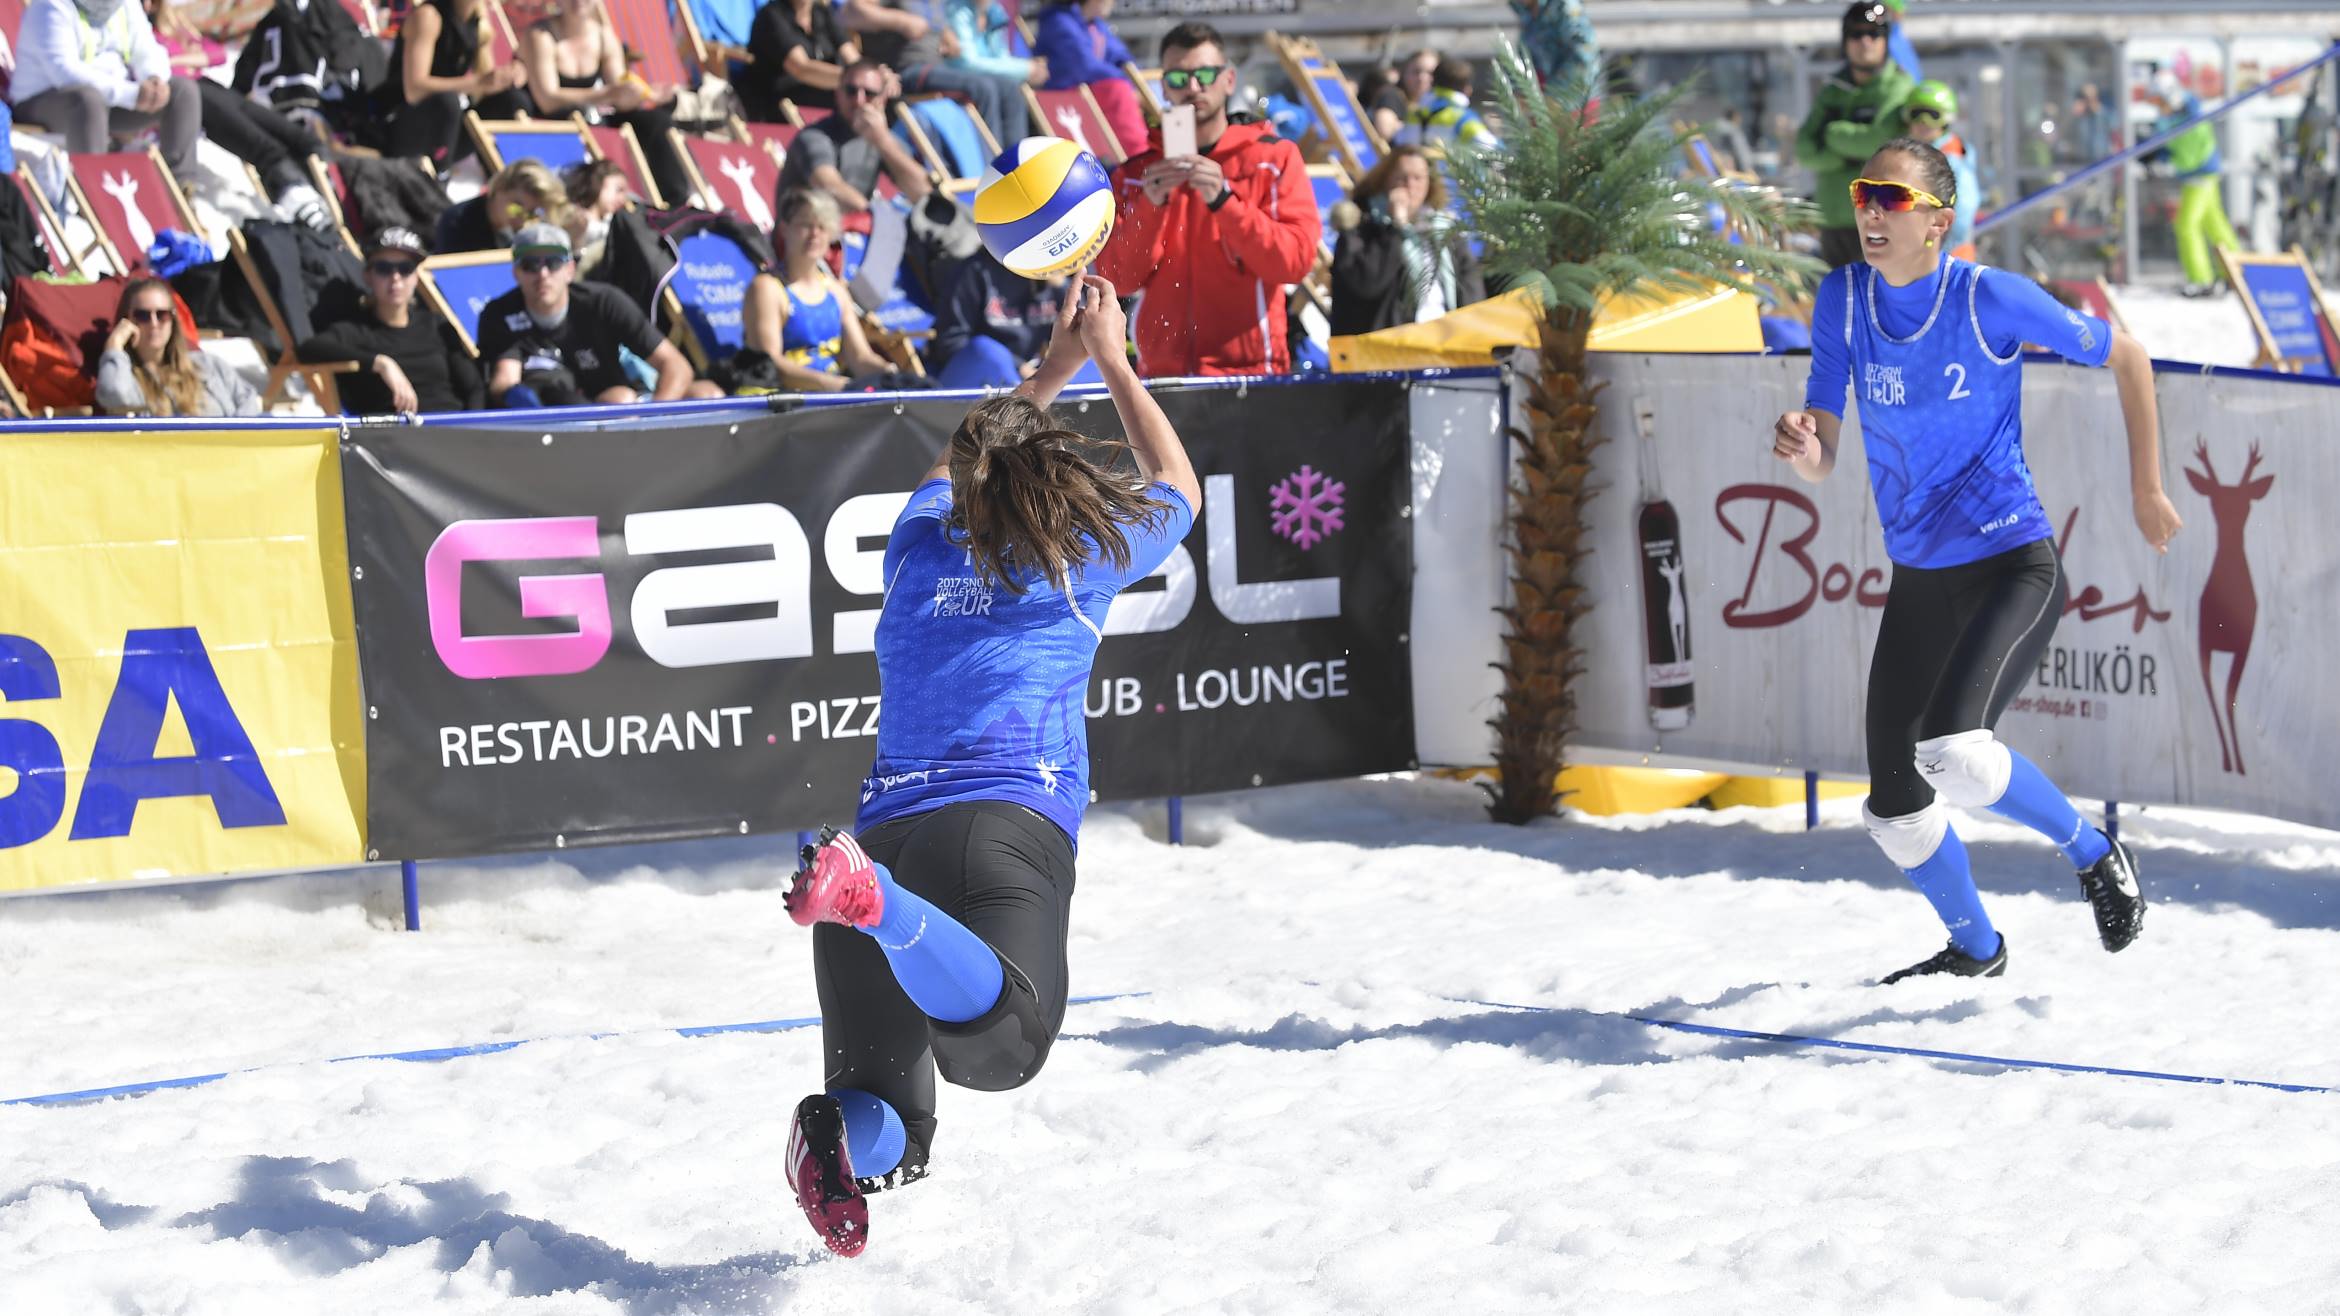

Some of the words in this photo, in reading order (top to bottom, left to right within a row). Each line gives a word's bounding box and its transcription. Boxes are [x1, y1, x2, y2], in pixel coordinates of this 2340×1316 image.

[1048, 232, 1080, 257] FIVB
[1944, 362, 1970, 400] 2
[936, 586, 994, 597] VOLLEYBALL
[937, 577, 961, 588] 2017
[2037, 645, 2158, 696] ERLIKÖR
[440, 706, 753, 768] RESTAURANT
[790, 695, 881, 743] PIZZ
[1084, 677, 1142, 718] UB
[1177, 659, 1349, 711] LOUNGE
